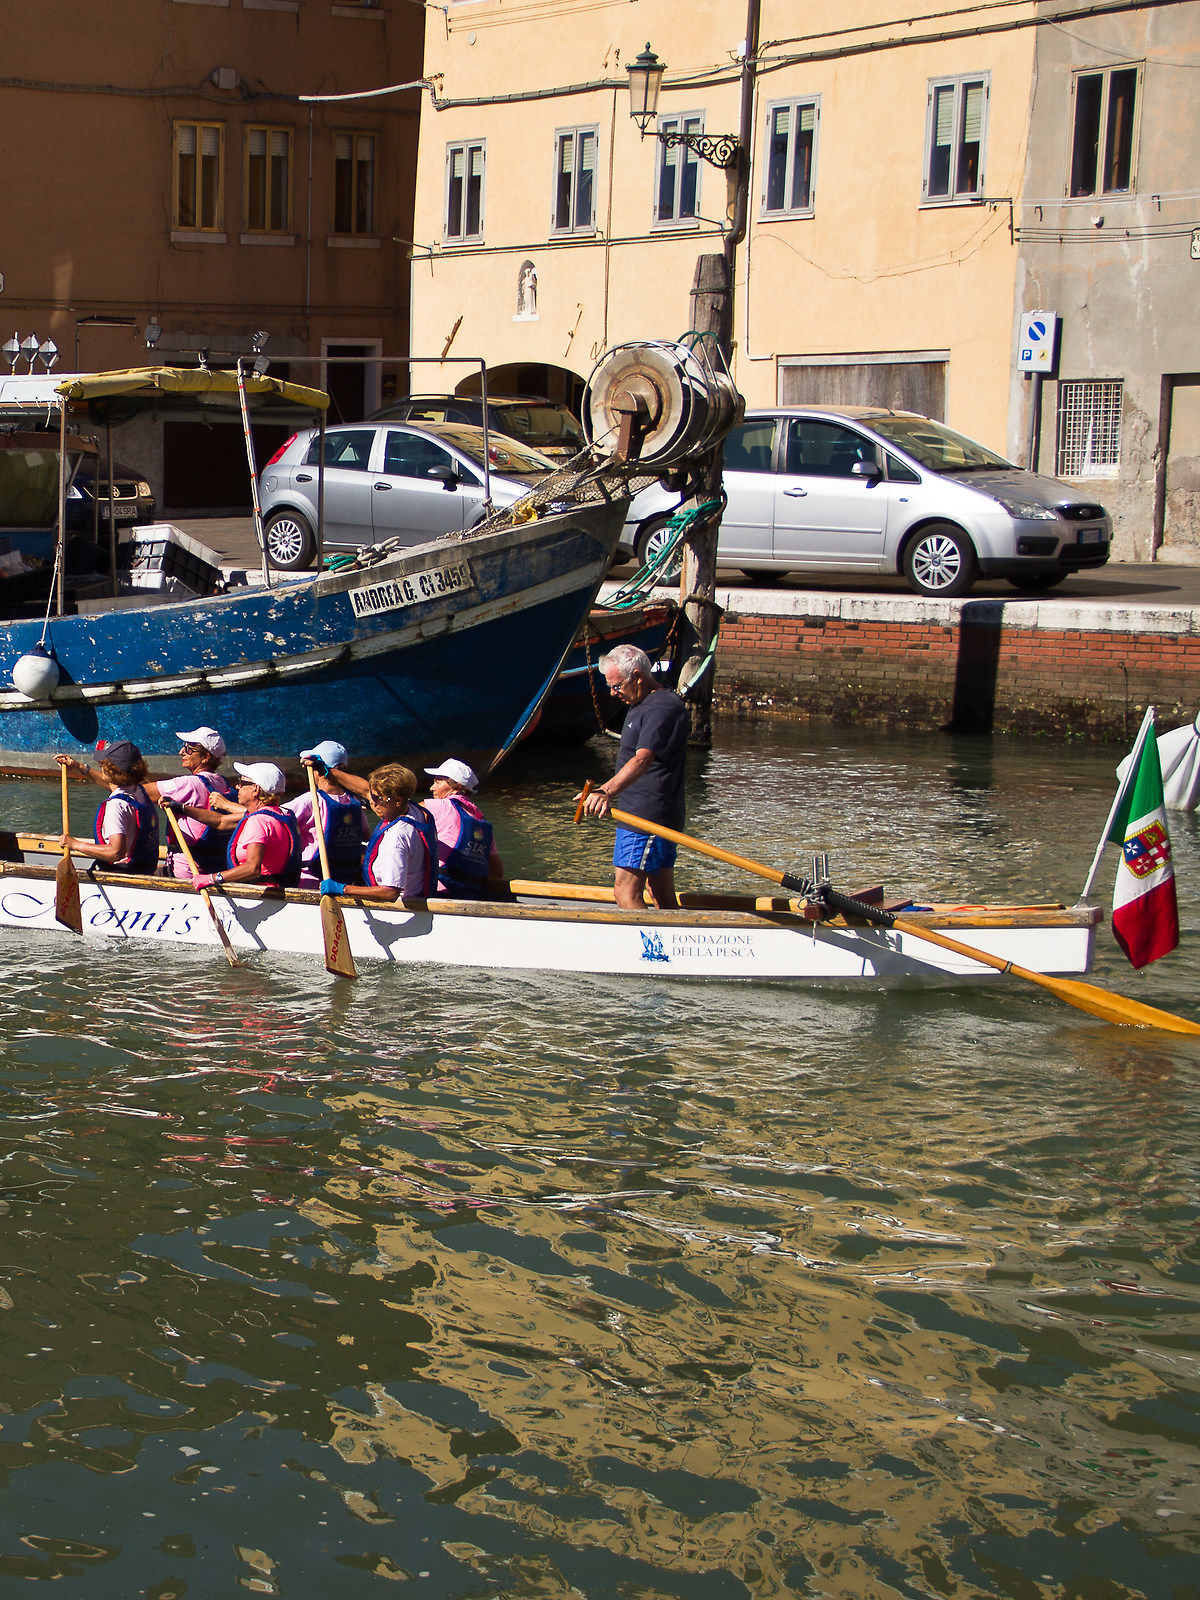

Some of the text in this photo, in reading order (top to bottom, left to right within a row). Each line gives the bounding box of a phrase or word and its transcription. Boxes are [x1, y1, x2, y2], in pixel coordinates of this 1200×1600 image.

[1023, 350, 1031, 360] P
[353, 583, 404, 613] ANDREA
[403, 579, 418, 600] G.
[330, 920, 343, 963] DRAGON
[672, 934, 753, 944] FONDAZIONE
[672, 946, 755, 957] DELLA PESCA
